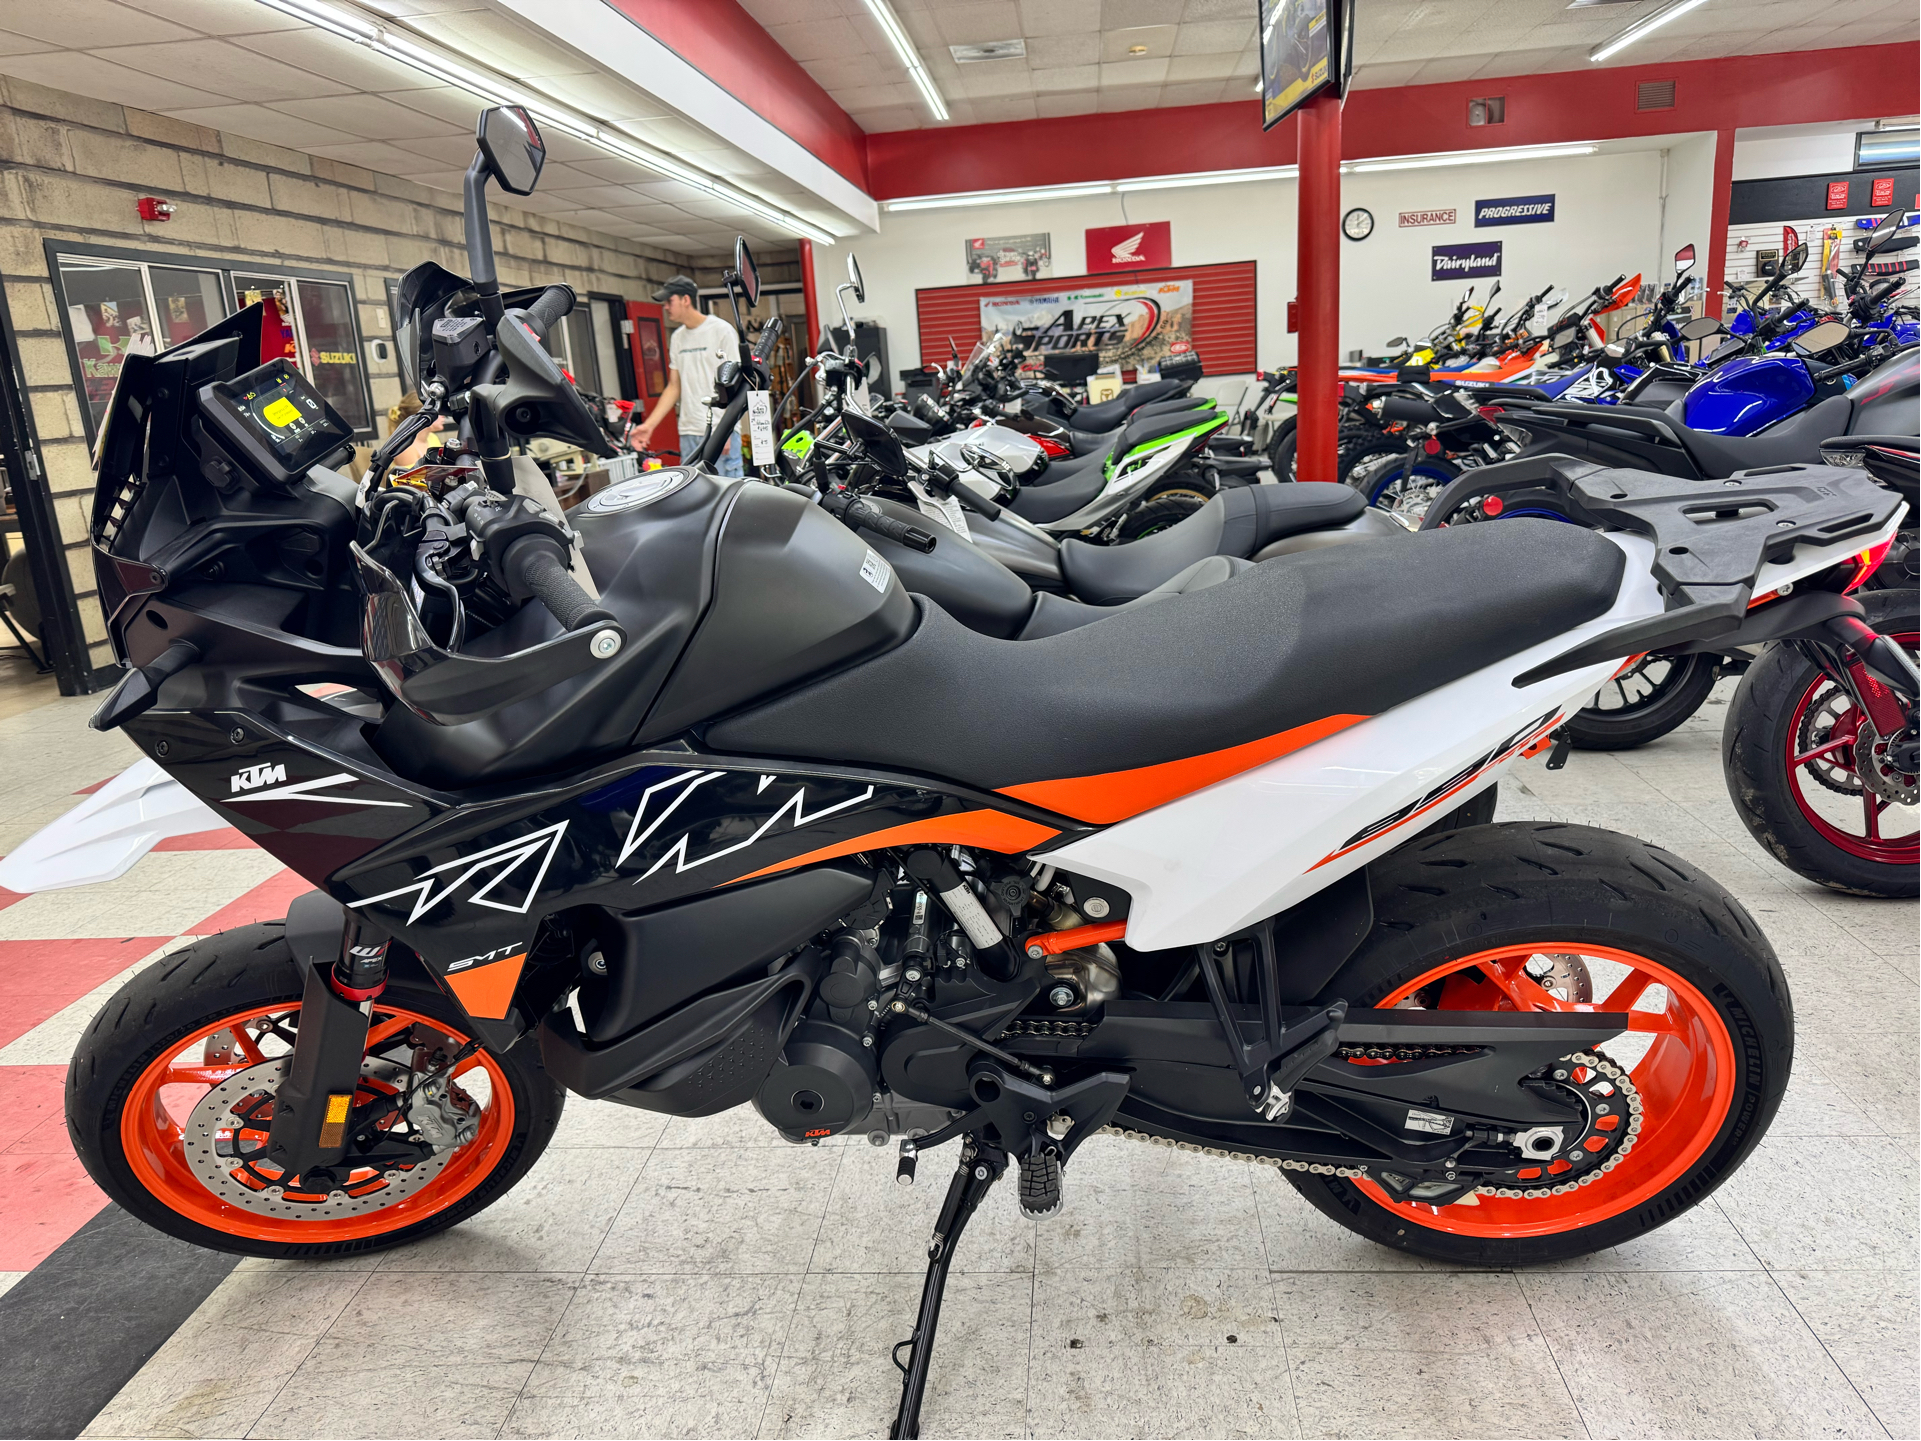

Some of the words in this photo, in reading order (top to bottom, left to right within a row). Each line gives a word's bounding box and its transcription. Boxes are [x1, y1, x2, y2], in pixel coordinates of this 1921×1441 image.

[1400, 211, 1454, 225] INSURANCE
[1478, 202, 1552, 219] PROGRESSIVE
[1112, 255, 1145, 264] HONDA
[1433, 253, 1499, 272] Dairyland
[1034, 297, 1060, 305] YAMAHA
[1043, 309, 1131, 333] APEX
[319, 352, 357, 364] SUZUKI
[1454, 380, 1489, 388] SUZUKI
[231, 762, 287, 793] KTM
[447, 941, 523, 972] SMT
[1730, 1006, 1761, 1086] MICHELIN
[108, 1053, 148, 1111] MICHELIN
[1735, 1094, 1756, 1142] POWER
[805, 1128, 830, 1137] KTM
[478, 1149, 520, 1198] MICHELIN
